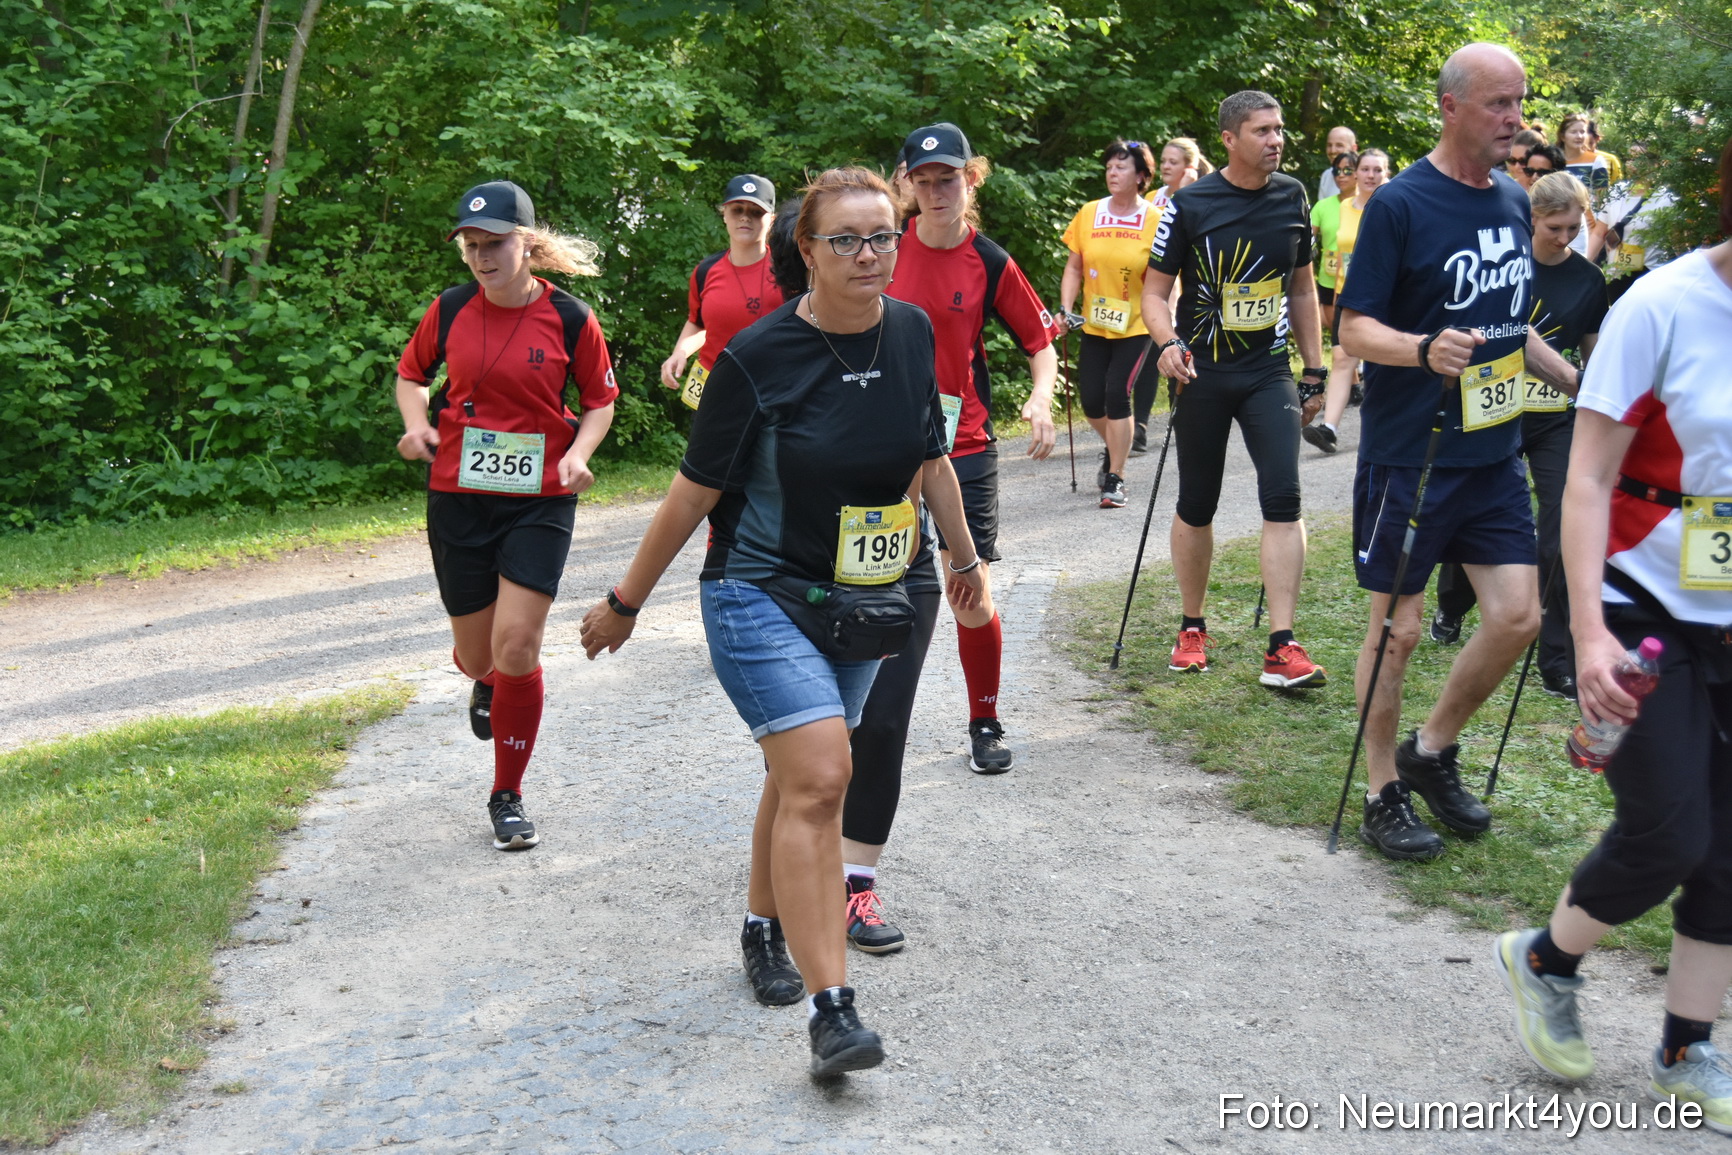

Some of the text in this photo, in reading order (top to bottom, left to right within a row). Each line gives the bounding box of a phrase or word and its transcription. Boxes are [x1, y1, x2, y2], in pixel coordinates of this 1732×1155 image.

[1091, 231, 1142, 240] MAX BÖGL
[746, 298, 760, 310] 25
[952, 292, 963, 306] 8
[1232, 296, 1274, 318] 1751
[1094, 307, 1123, 323] 1544
[527, 347, 545, 364] 18
[688, 378, 703, 398] 23
[1480, 377, 1516, 410] 387
[470, 450, 533, 476] 2356
[856, 520, 893, 530] firmenlauf
[853, 528, 908, 562] 1981
[1710, 531, 1731, 564] 3
[866, 563, 881, 571] Link
